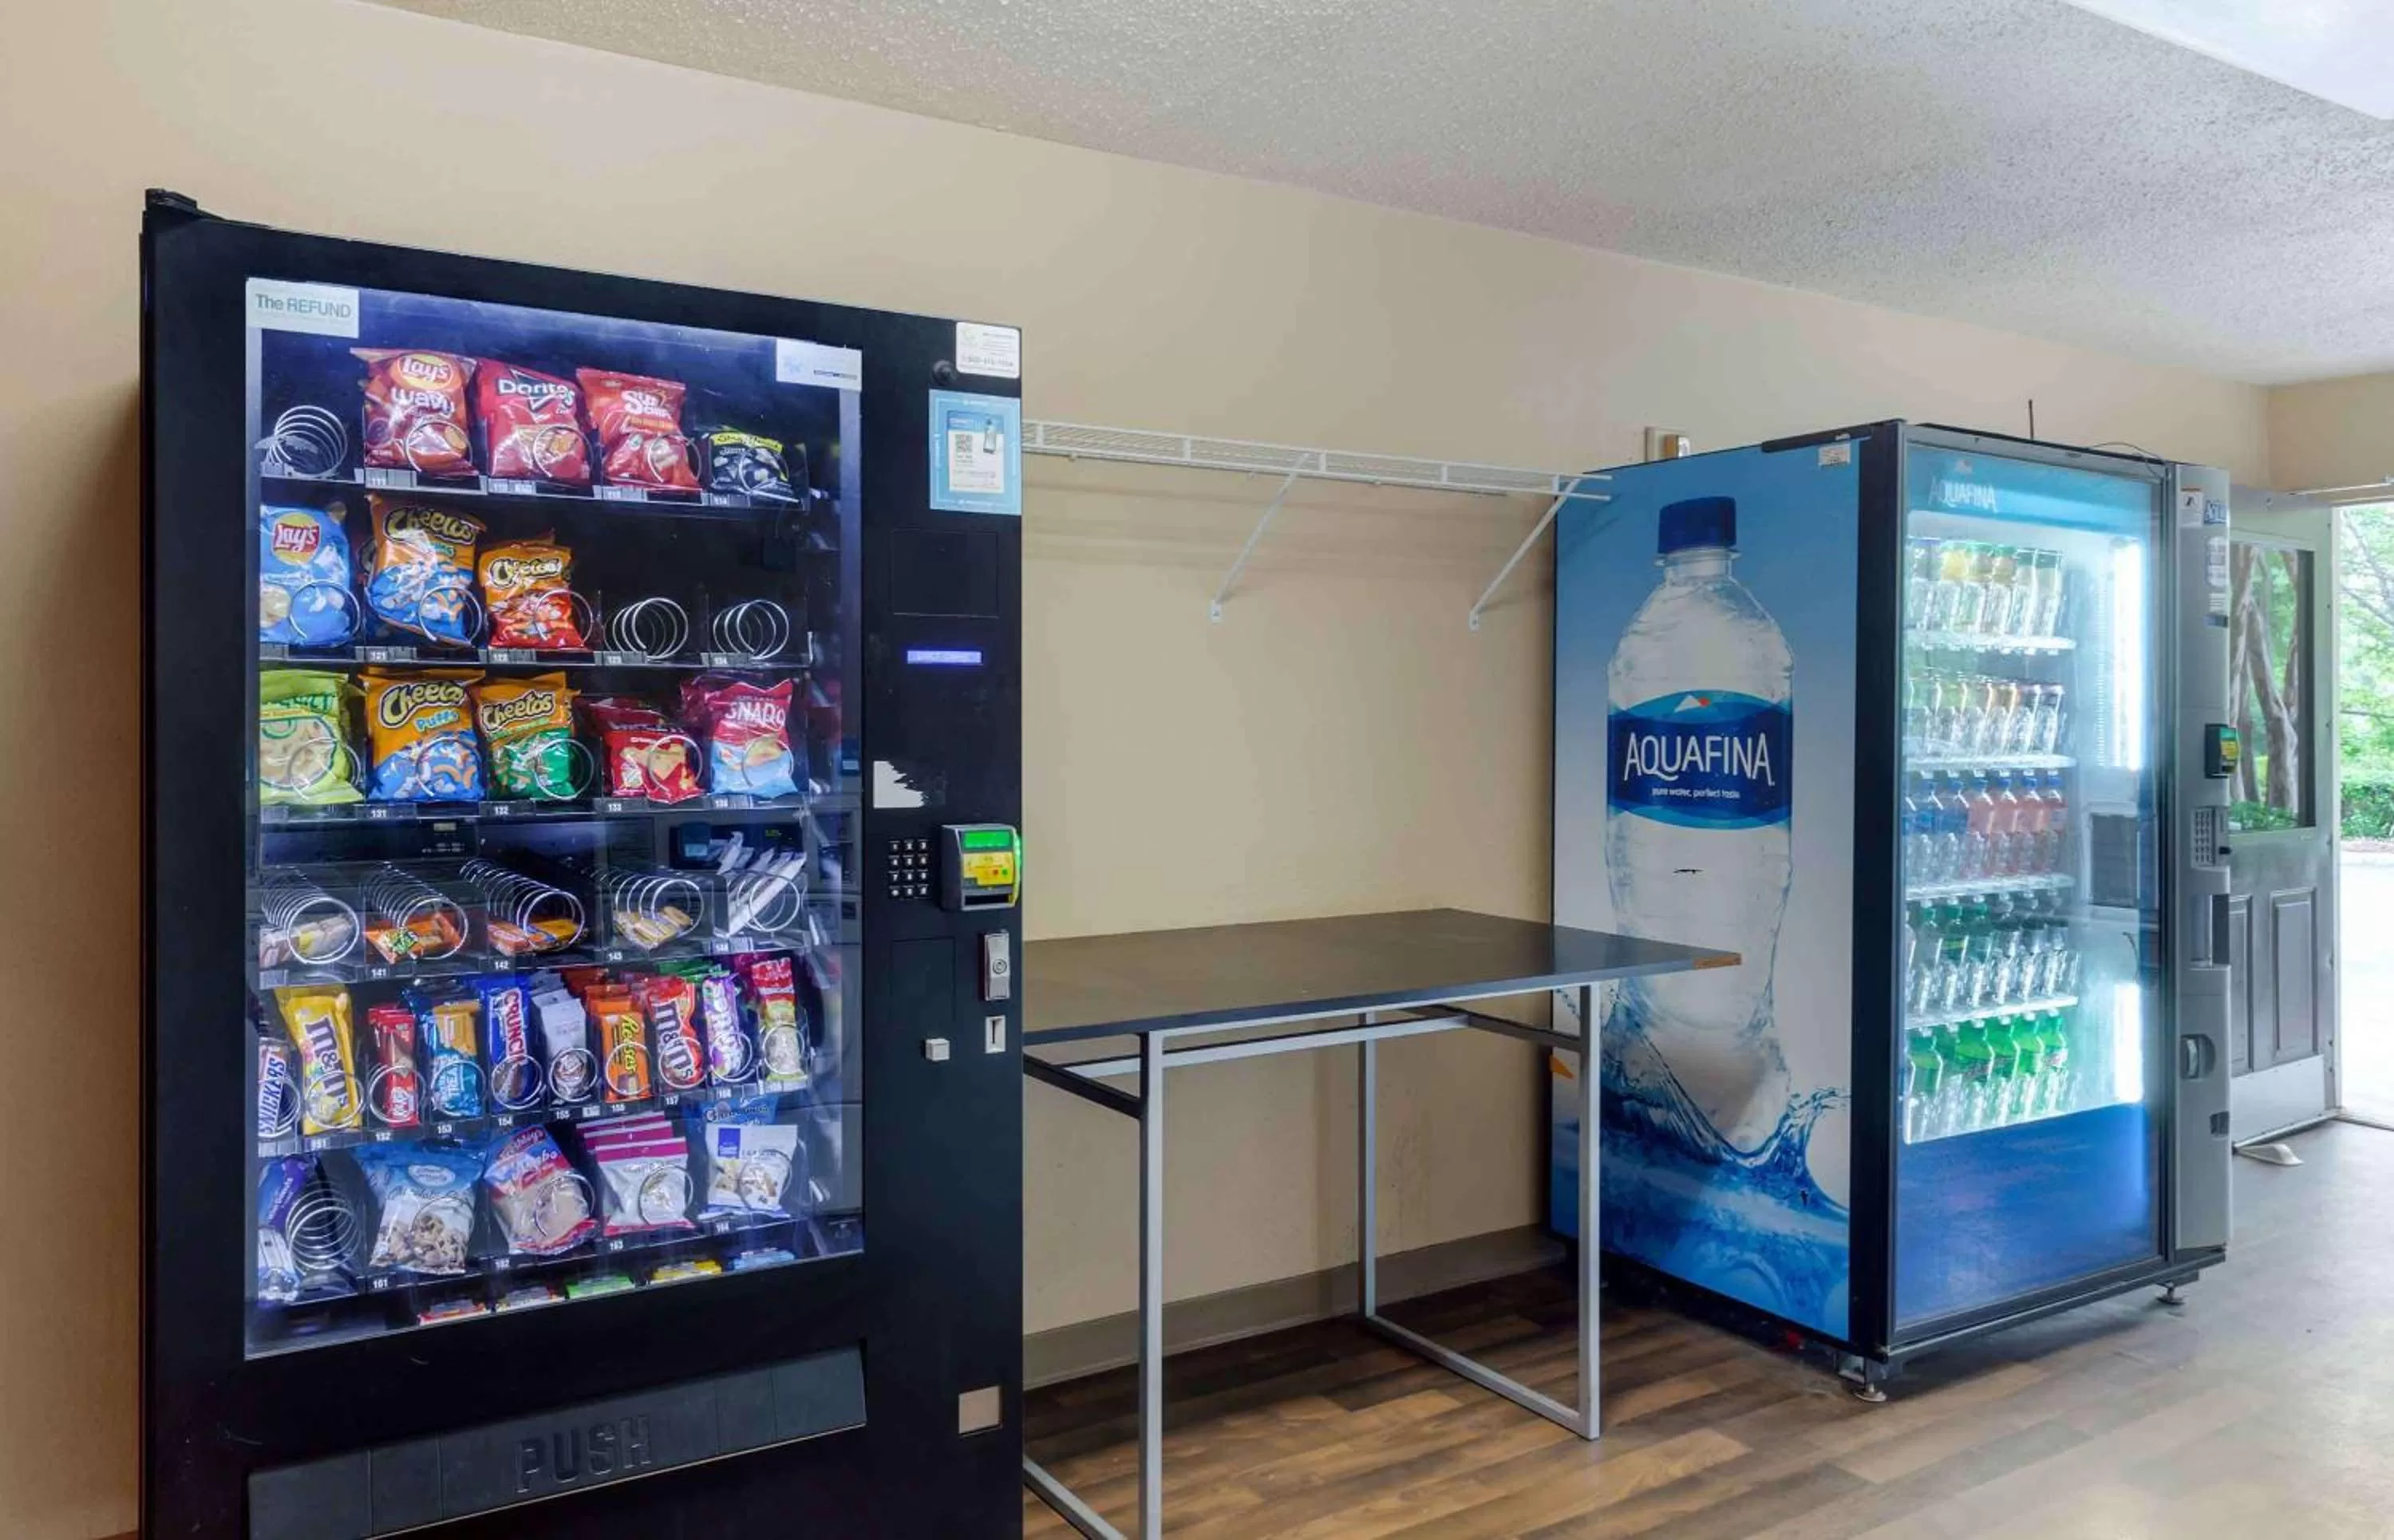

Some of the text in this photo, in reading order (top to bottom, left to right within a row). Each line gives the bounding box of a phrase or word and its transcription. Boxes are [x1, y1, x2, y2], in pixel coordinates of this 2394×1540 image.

[255, 294, 351, 318] The REFUND
[401, 357, 451, 382] Lay's
[497, 378, 576, 406] Doritos
[1929, 478, 1997, 513] AQUAFINA
[274, 524, 319, 551] Lay's
[382, 683, 464, 726] Cheetos
[483, 693, 551, 730] Cheetos
[1623, 731, 1776, 787] AQUAFINA
[371, 809, 387, 818] 131
[494, 806, 508, 815] 132
[371, 968, 387, 977] 141
[495, 959, 510, 969] 142
[258, 1056, 286, 1136] SNICKERS
[515, 1417, 652, 1494] PUSH
